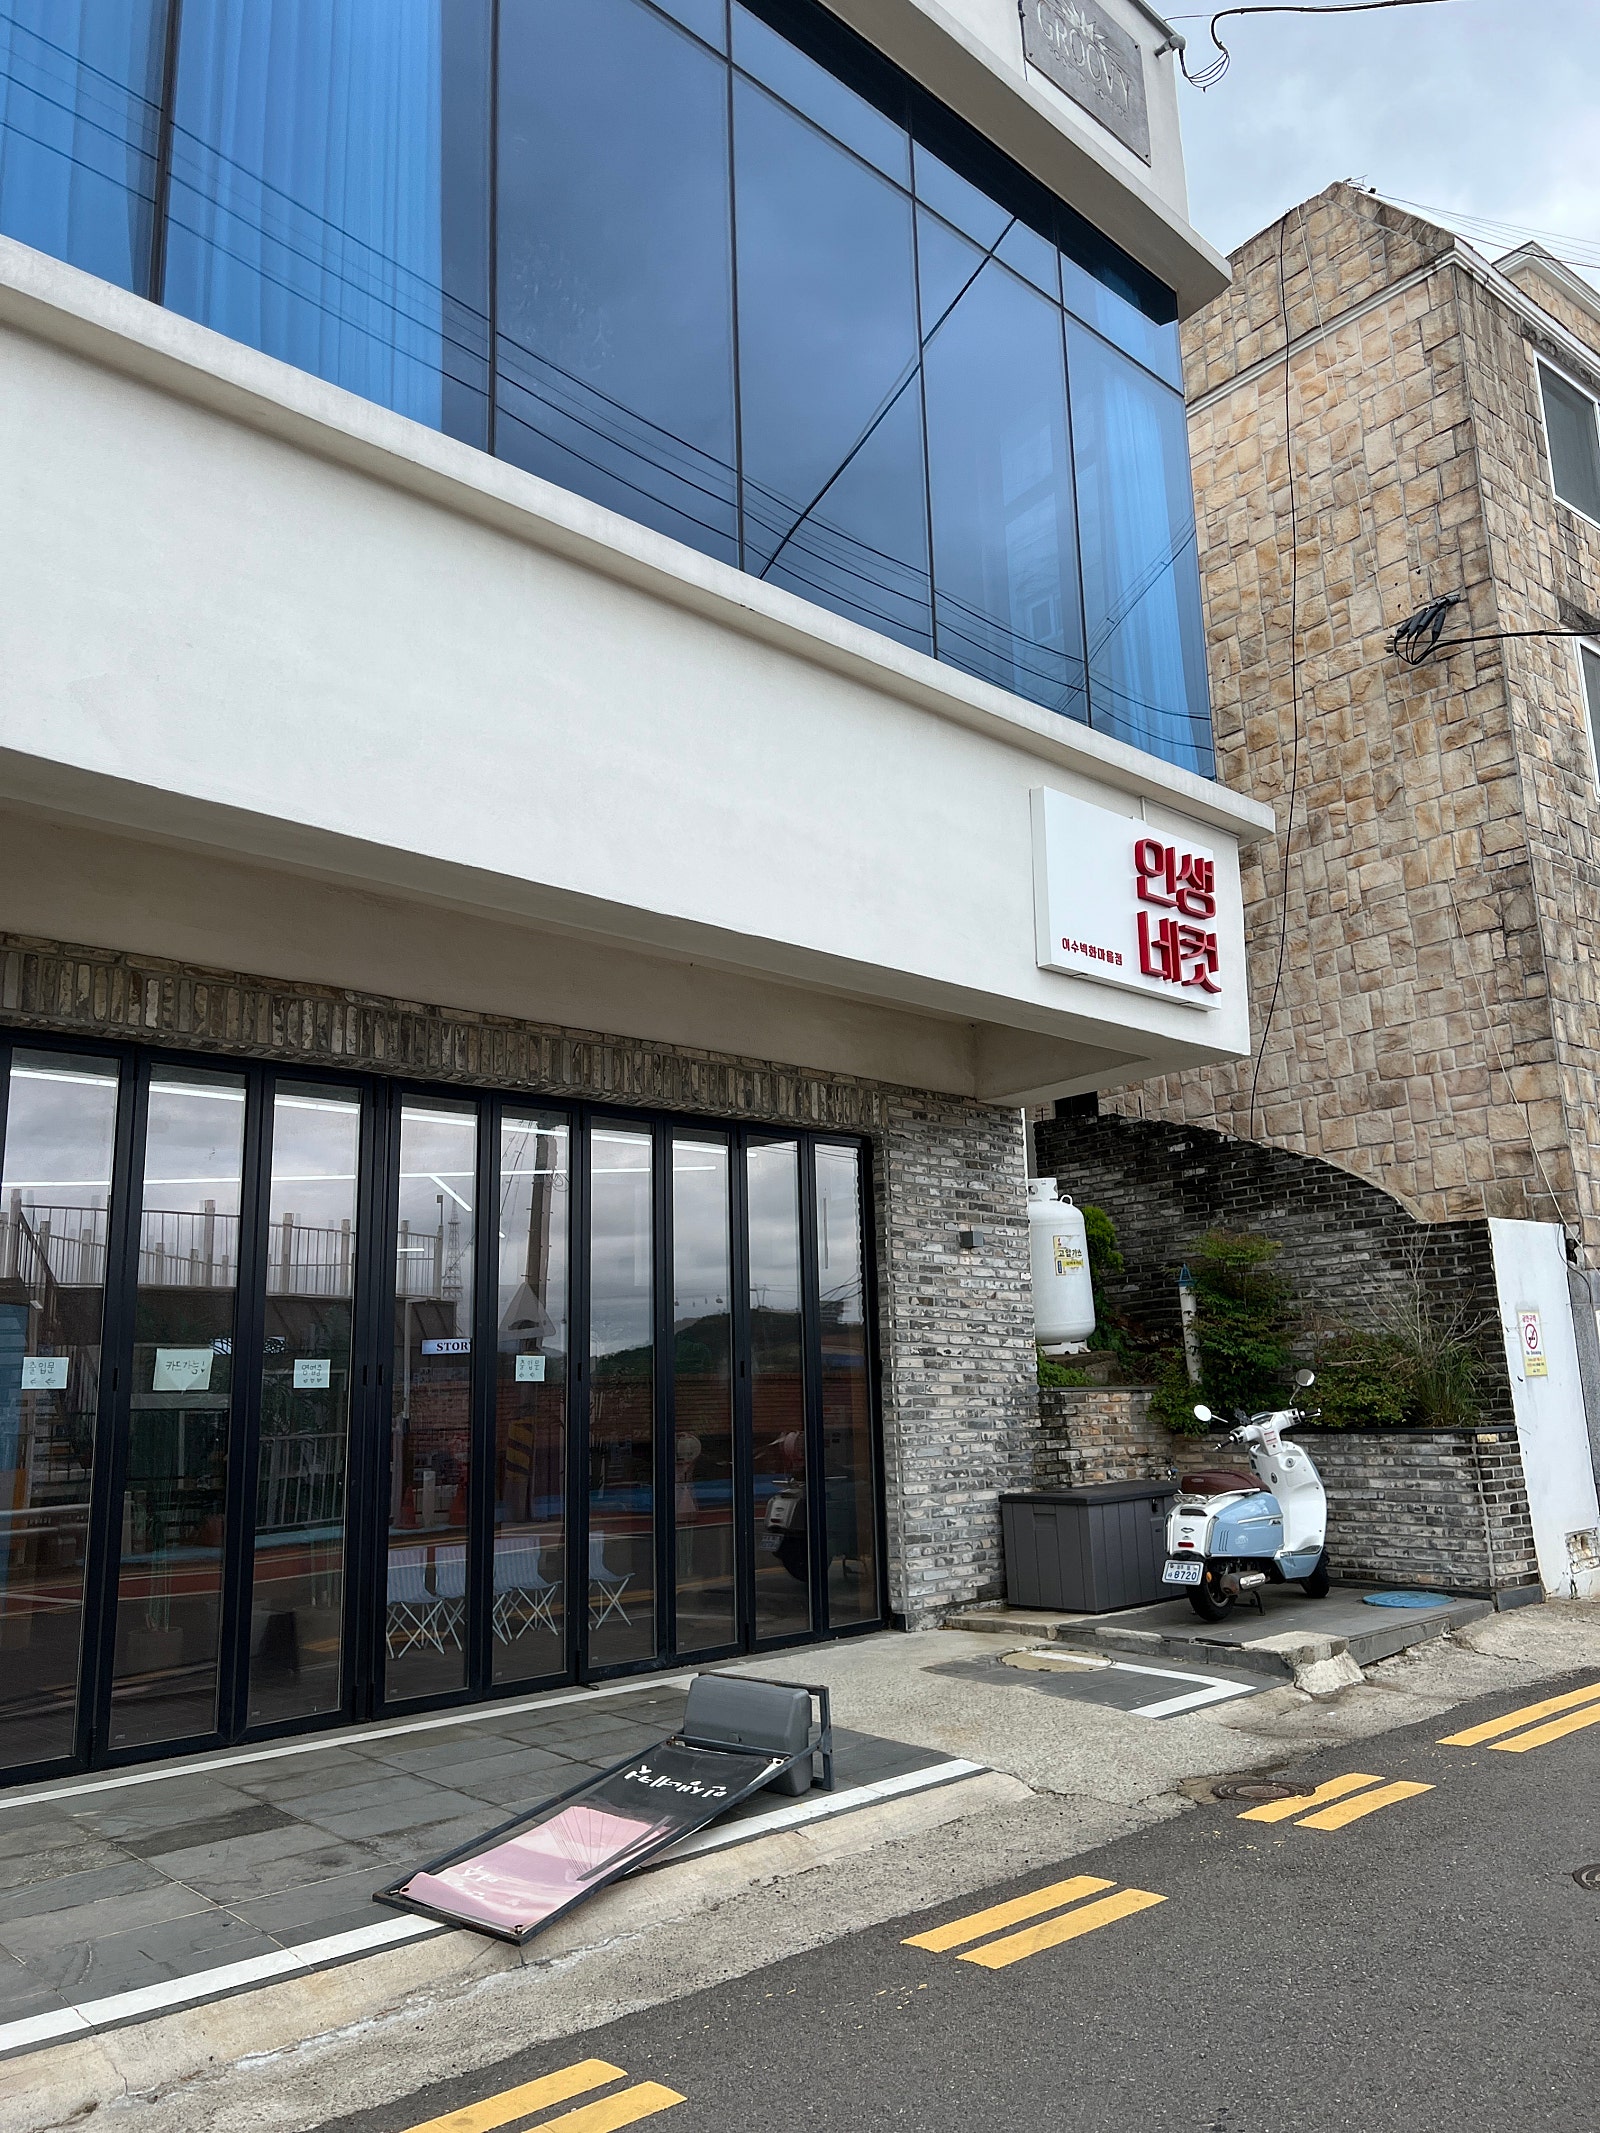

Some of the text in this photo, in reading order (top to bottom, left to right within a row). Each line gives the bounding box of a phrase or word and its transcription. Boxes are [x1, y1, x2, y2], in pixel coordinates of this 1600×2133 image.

[1037, 1, 1131, 109] GROOVY
[1134, 838, 1216, 919] 인생
[1061, 937, 1123, 966] 여수벽화마을점
[1137, 911, 1222, 994] 네컷
[1058, 1248, 1083, 1258] 고압가스
[436, 1341, 471, 1351] STOR
[28, 1361, 55, 1375] 출입문
[1174, 1570, 1197, 1581] 8720
[624, 1764, 728, 1798] 인생네컷
